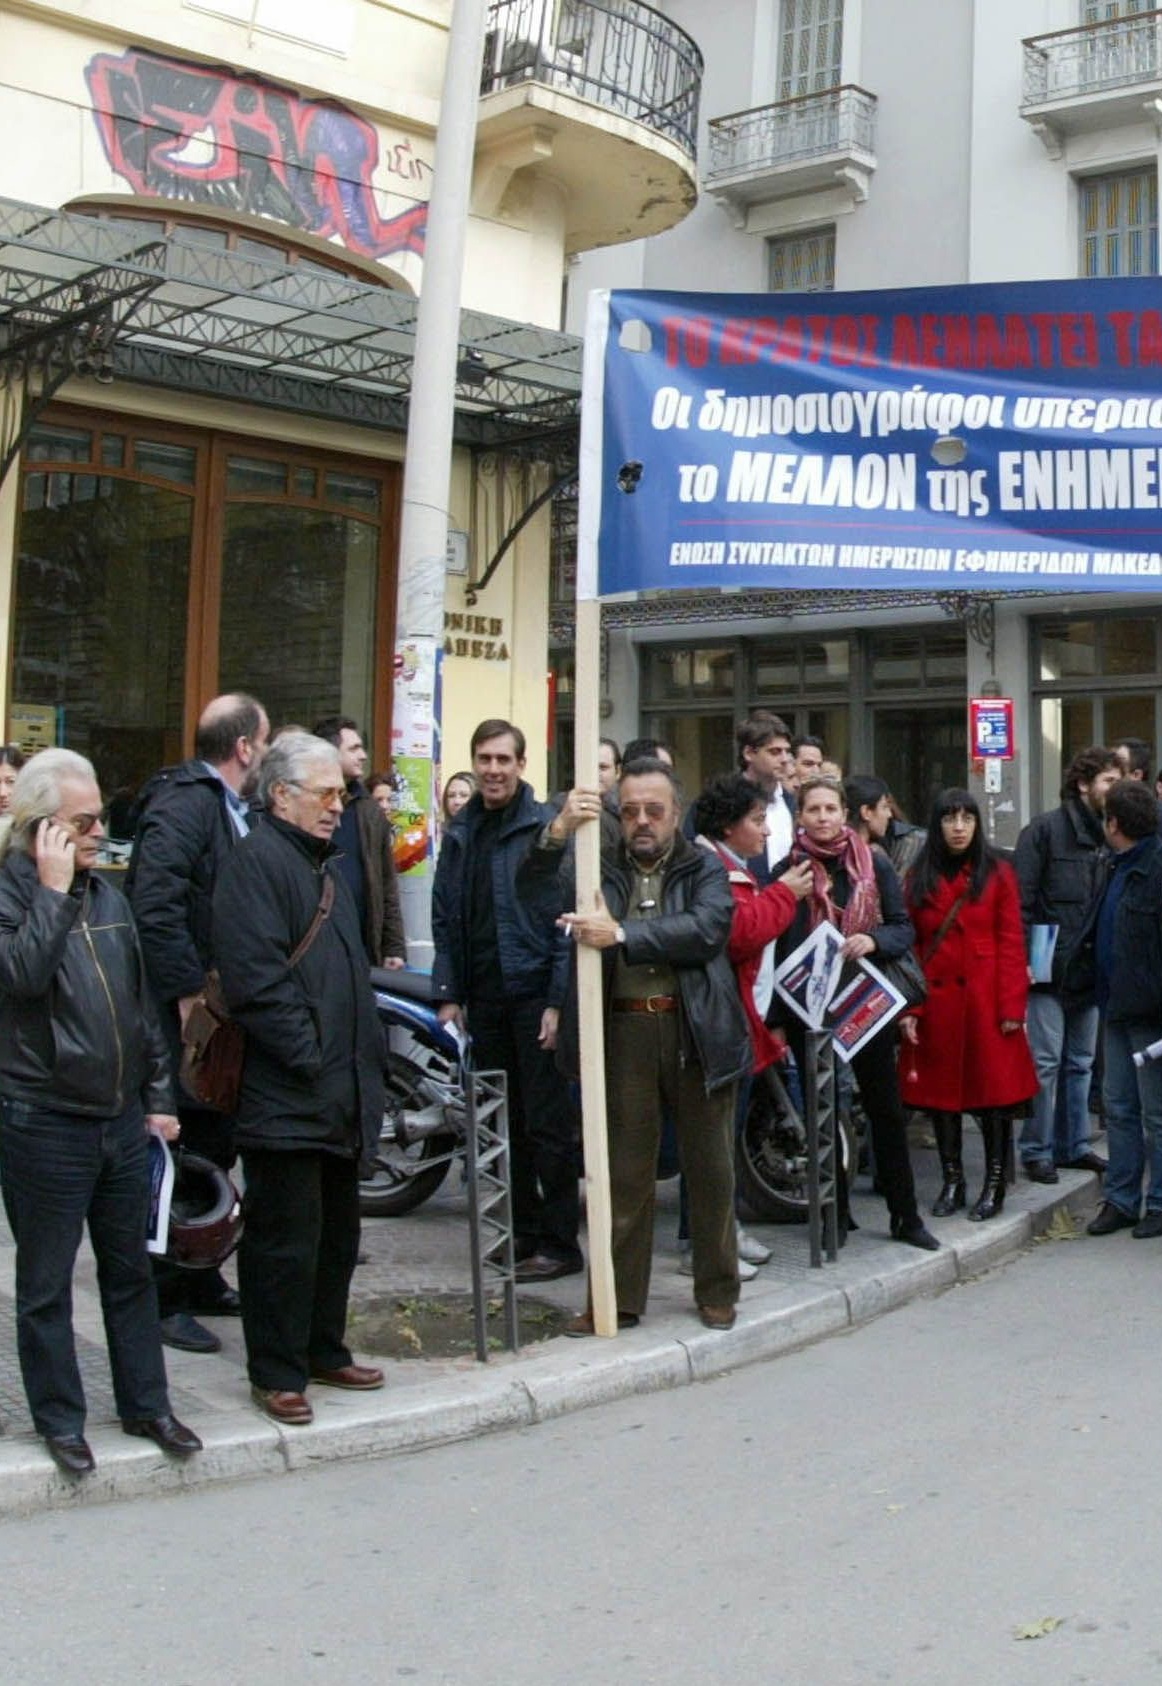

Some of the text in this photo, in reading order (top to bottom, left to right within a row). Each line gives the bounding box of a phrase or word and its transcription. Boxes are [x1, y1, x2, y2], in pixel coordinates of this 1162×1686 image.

[662, 315, 712, 368] ΤΟ
[719, 314, 881, 369] ΚΡΑΤΟΣ
[890, 311, 1099, 370] ΛΕΗΛΑΤΕΙ
[651, 386, 692, 430] Οι
[697, 384, 1006, 438] δημοσιογράφοι
[678, 463, 720, 504] το
[726, 450, 917, 512] ΜΕΛΛΟΝ
[926, 469, 990, 517] της
[669, 541, 726, 566] ΕΝΩΣΗ
[727, 541, 835, 568] ΣΥΝΤΑΚΤΩΝ
[838, 544, 952, 572] ΗΜΕΡΗΣΙΩΝ
[953, 549, 1089, 574] ΕΦΗΜΕΡΙΔΩΝ
